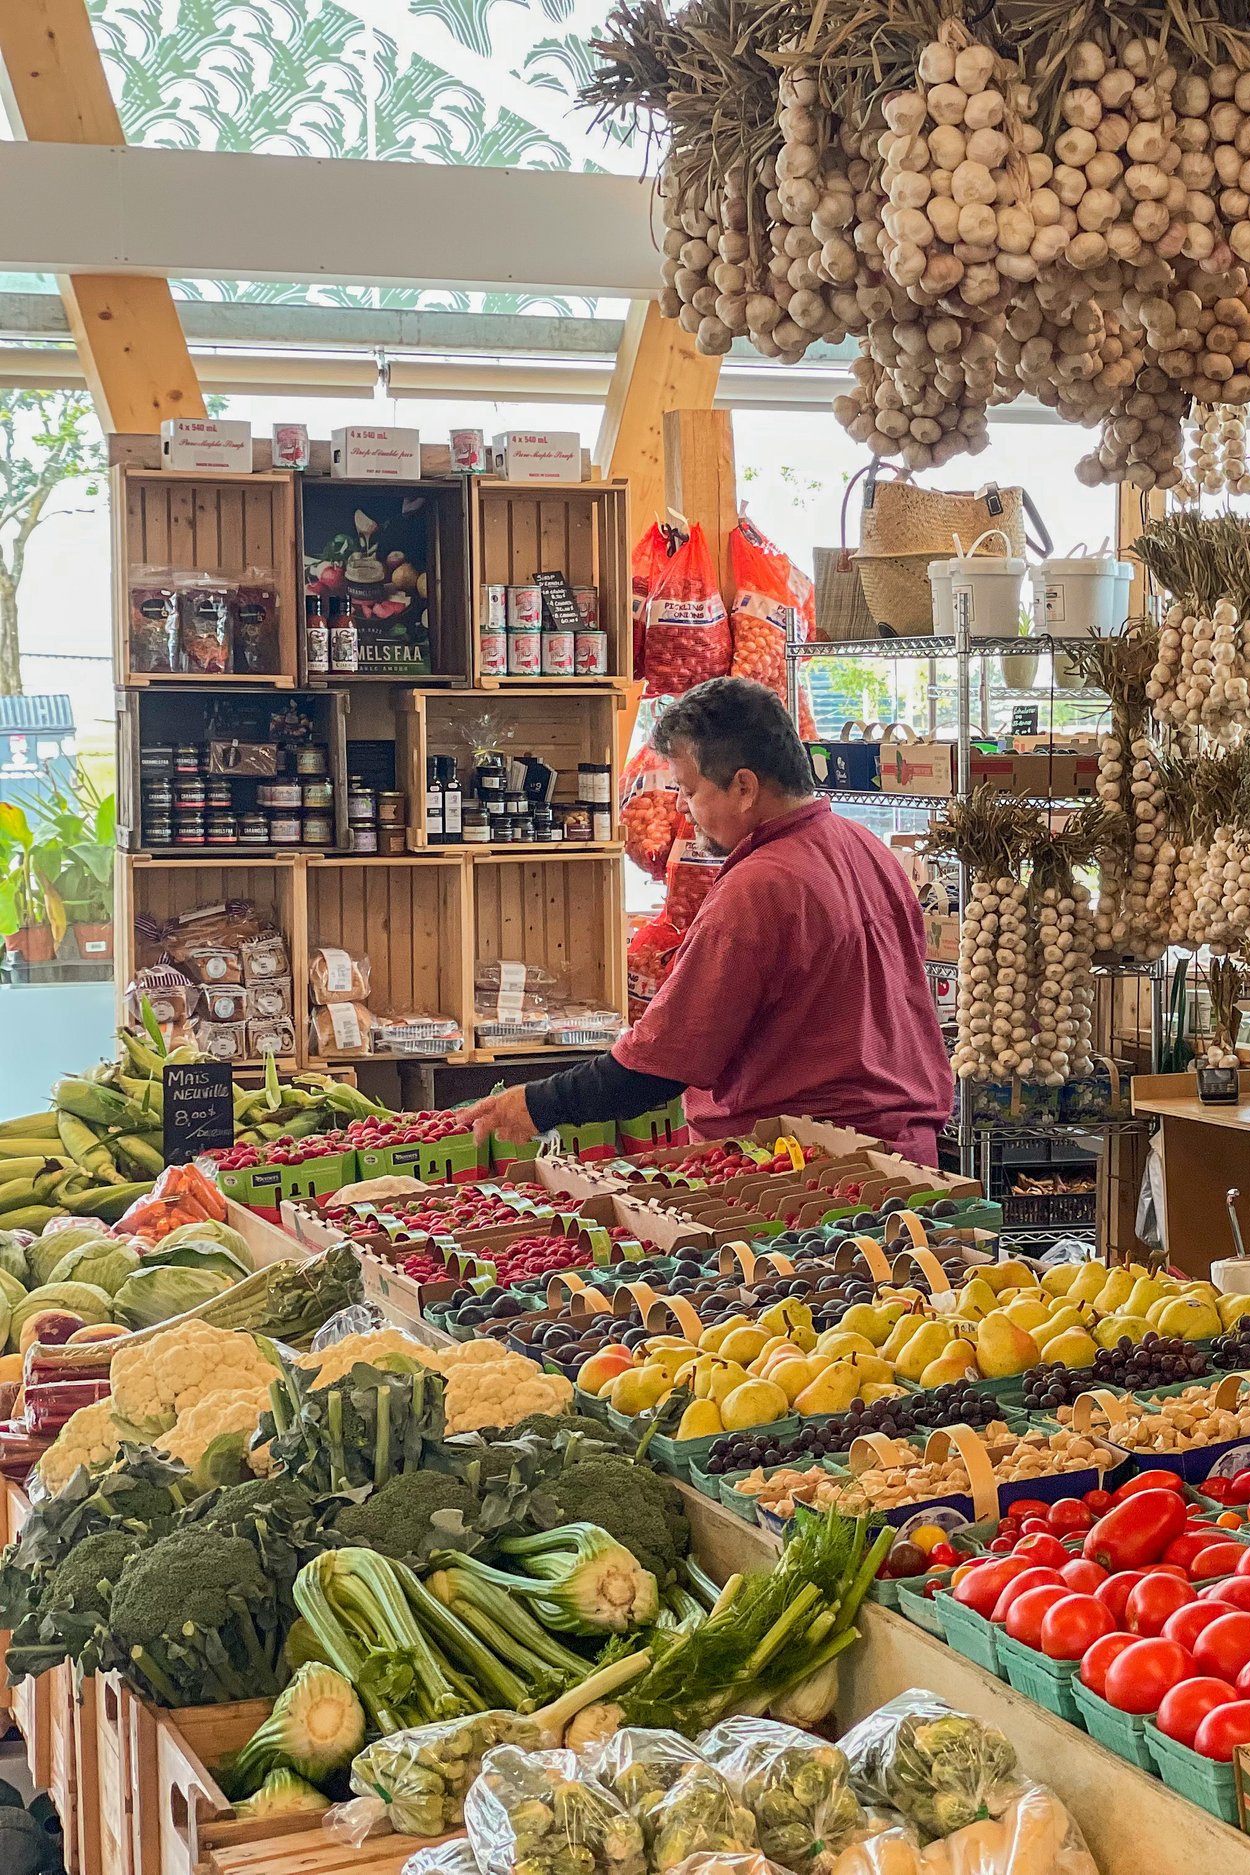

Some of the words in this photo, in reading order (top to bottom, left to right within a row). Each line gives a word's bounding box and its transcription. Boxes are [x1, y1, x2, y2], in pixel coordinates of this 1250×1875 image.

[191, 423, 205, 432] 540
[362, 431, 375, 439] 540
[663, 602, 704, 612] PICKLING
[673, 611, 705, 619] ONIONS
